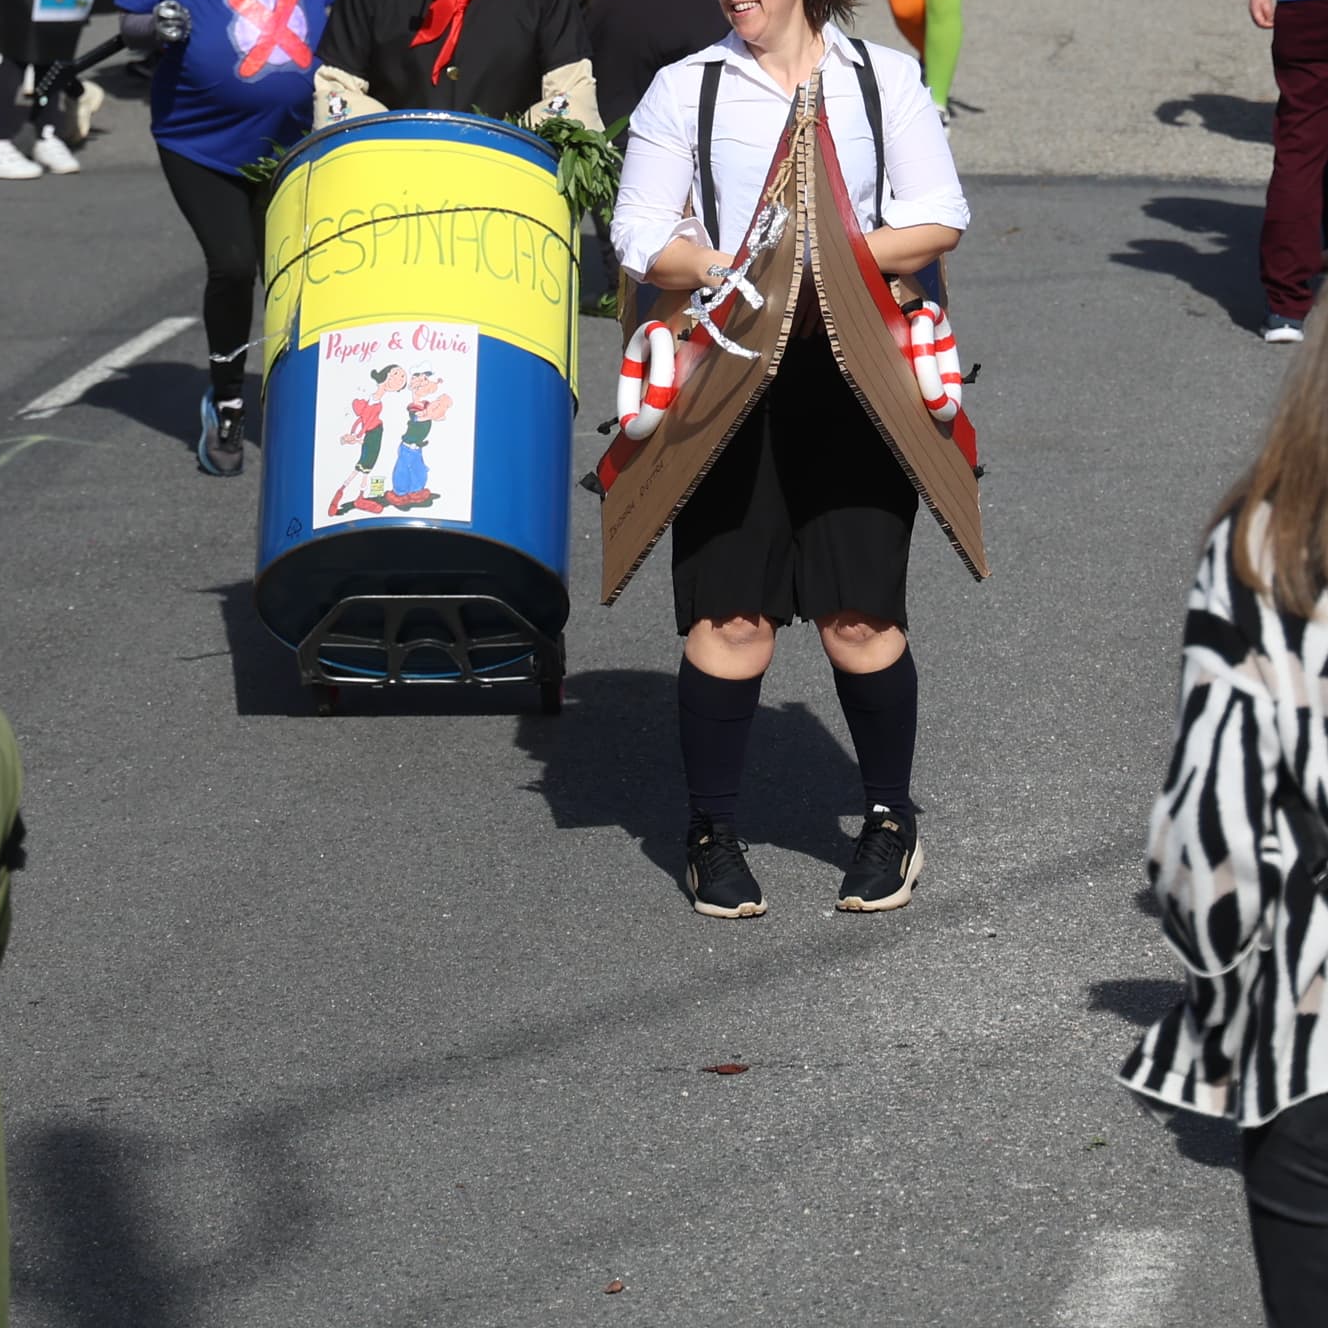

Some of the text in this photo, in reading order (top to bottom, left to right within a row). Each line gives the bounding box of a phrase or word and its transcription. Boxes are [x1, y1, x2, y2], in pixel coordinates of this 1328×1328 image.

[304, 190, 562, 305] ESPINACAS
[325, 323, 470, 363] Popeye & Olivia
